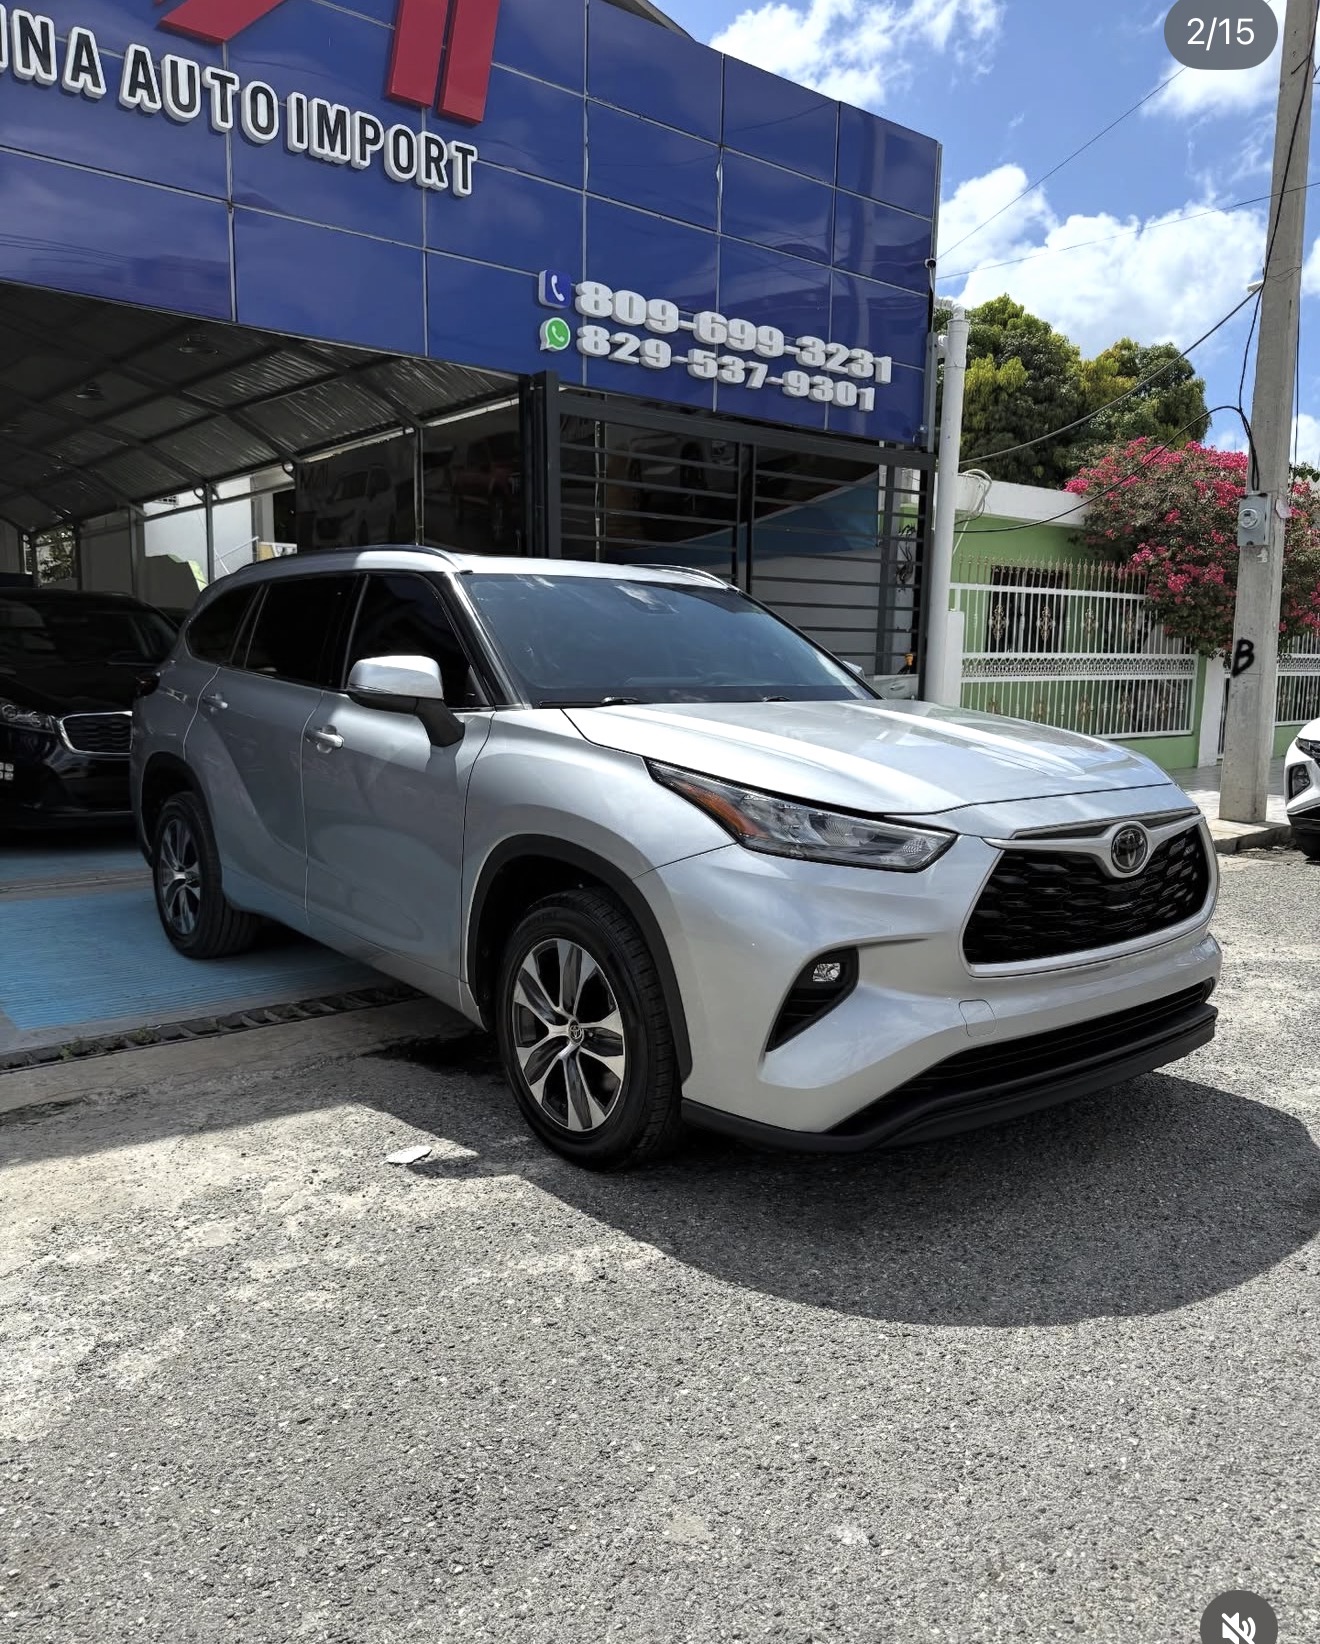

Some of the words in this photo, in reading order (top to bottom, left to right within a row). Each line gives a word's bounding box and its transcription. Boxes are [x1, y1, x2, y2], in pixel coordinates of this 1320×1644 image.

[119, 43, 280, 144] AUTO
[287, 92, 478, 198] IMPORT
[575, 280, 892, 384] 809-699-3231
[577, 325, 875, 412] 829-537-9301
[1232, 639, 1255, 677] B
